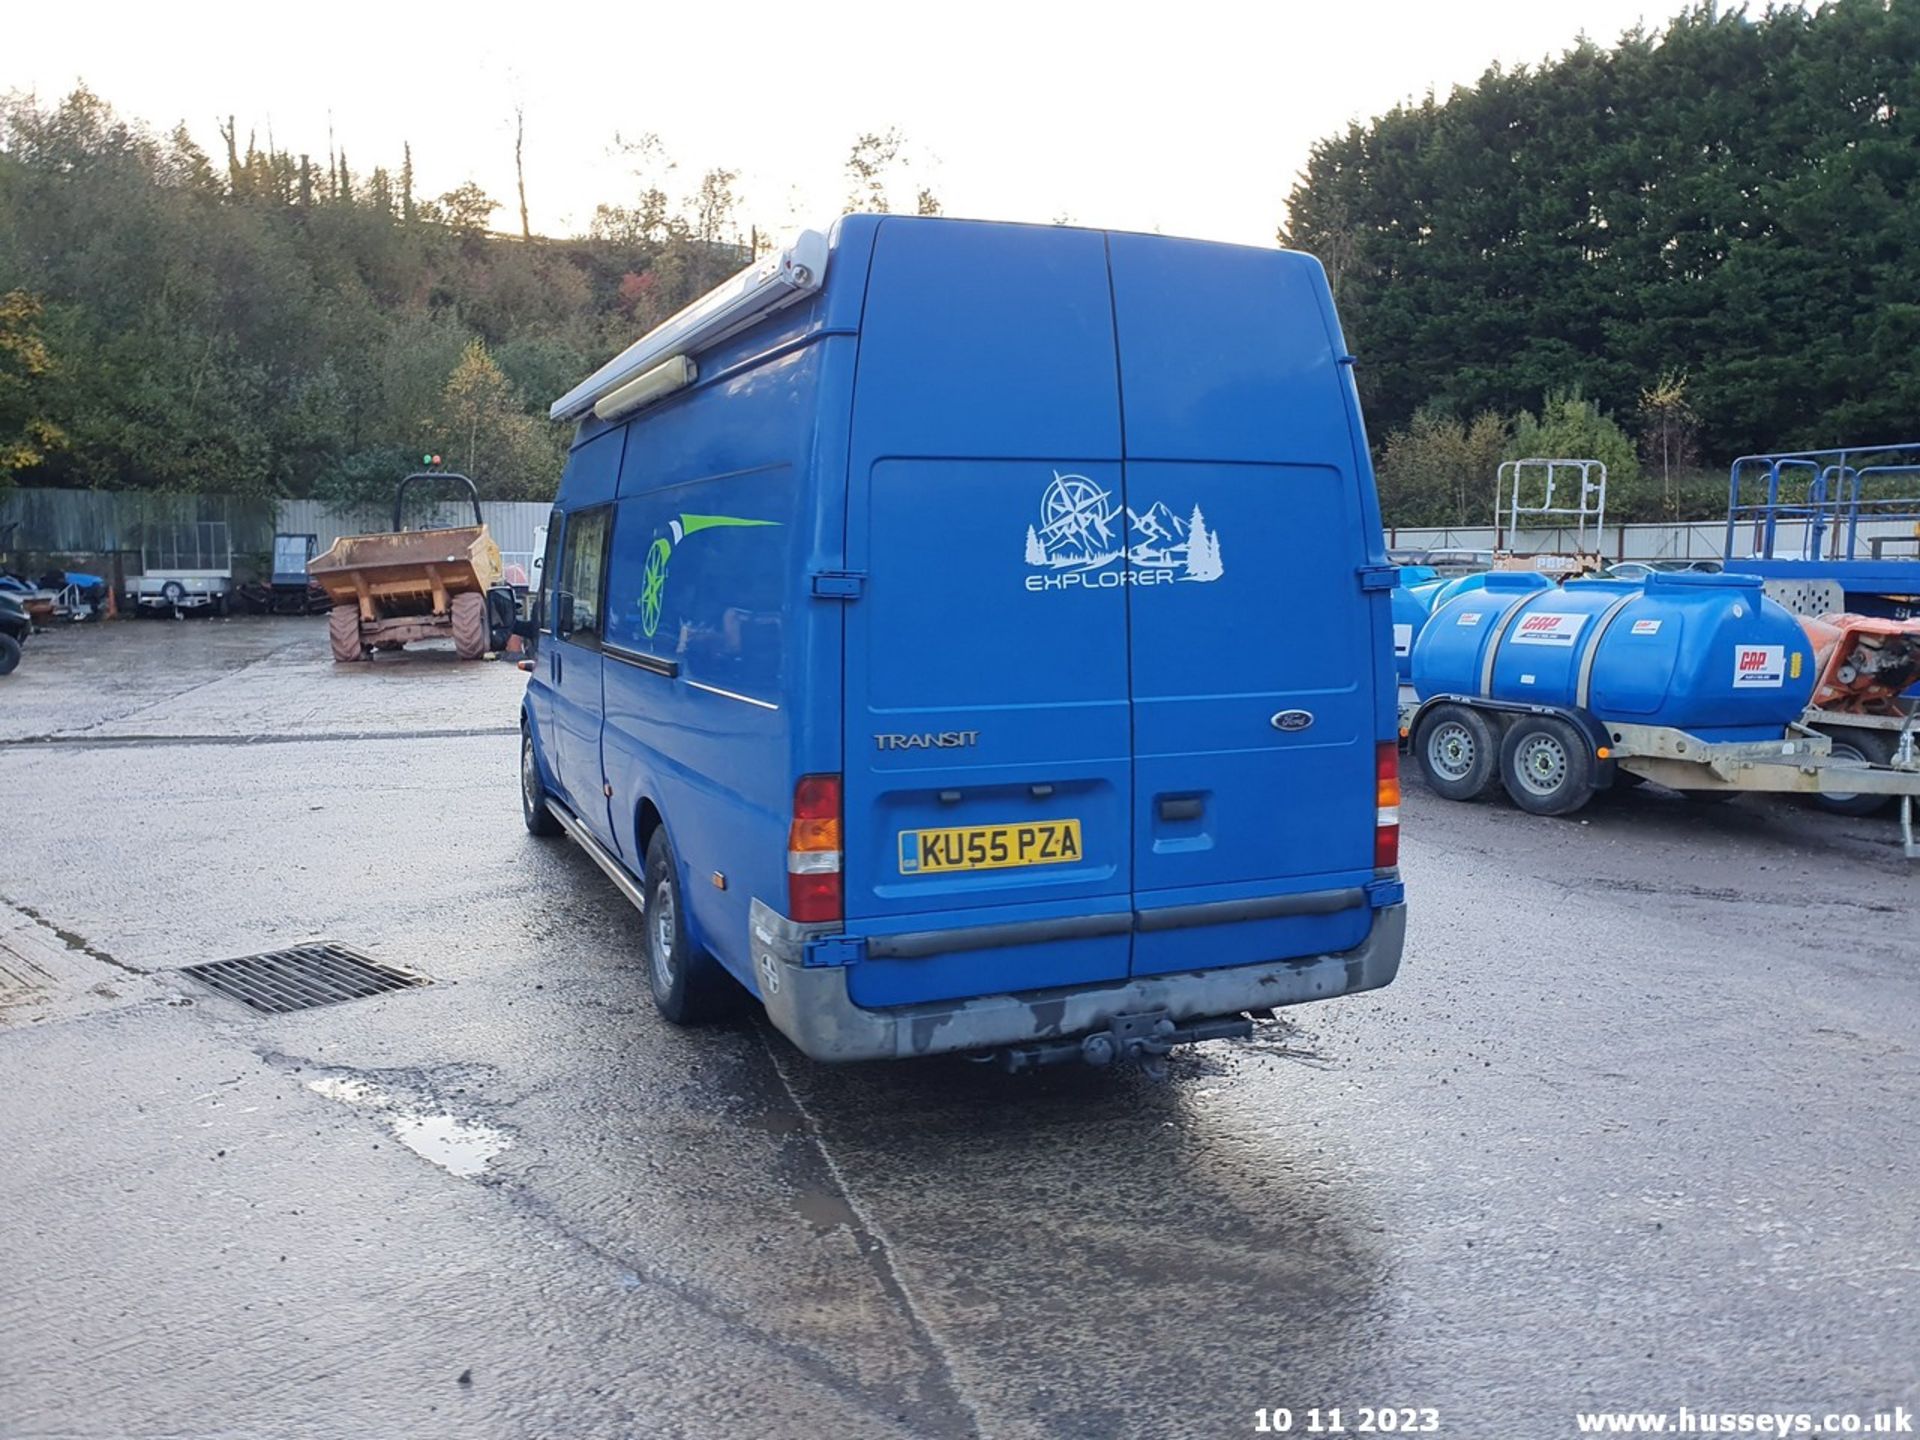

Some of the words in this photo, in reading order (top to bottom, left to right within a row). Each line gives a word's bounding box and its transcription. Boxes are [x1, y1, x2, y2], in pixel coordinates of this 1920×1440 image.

[1025, 569, 1174, 591] EXPLORER
[1521, 616, 1562, 631] GAP
[1740, 651, 1767, 671] GAP
[873, 731, 980, 750] TRANSIT
[922, 830, 1009, 867] KU55
[1018, 825, 1077, 860] PZA
